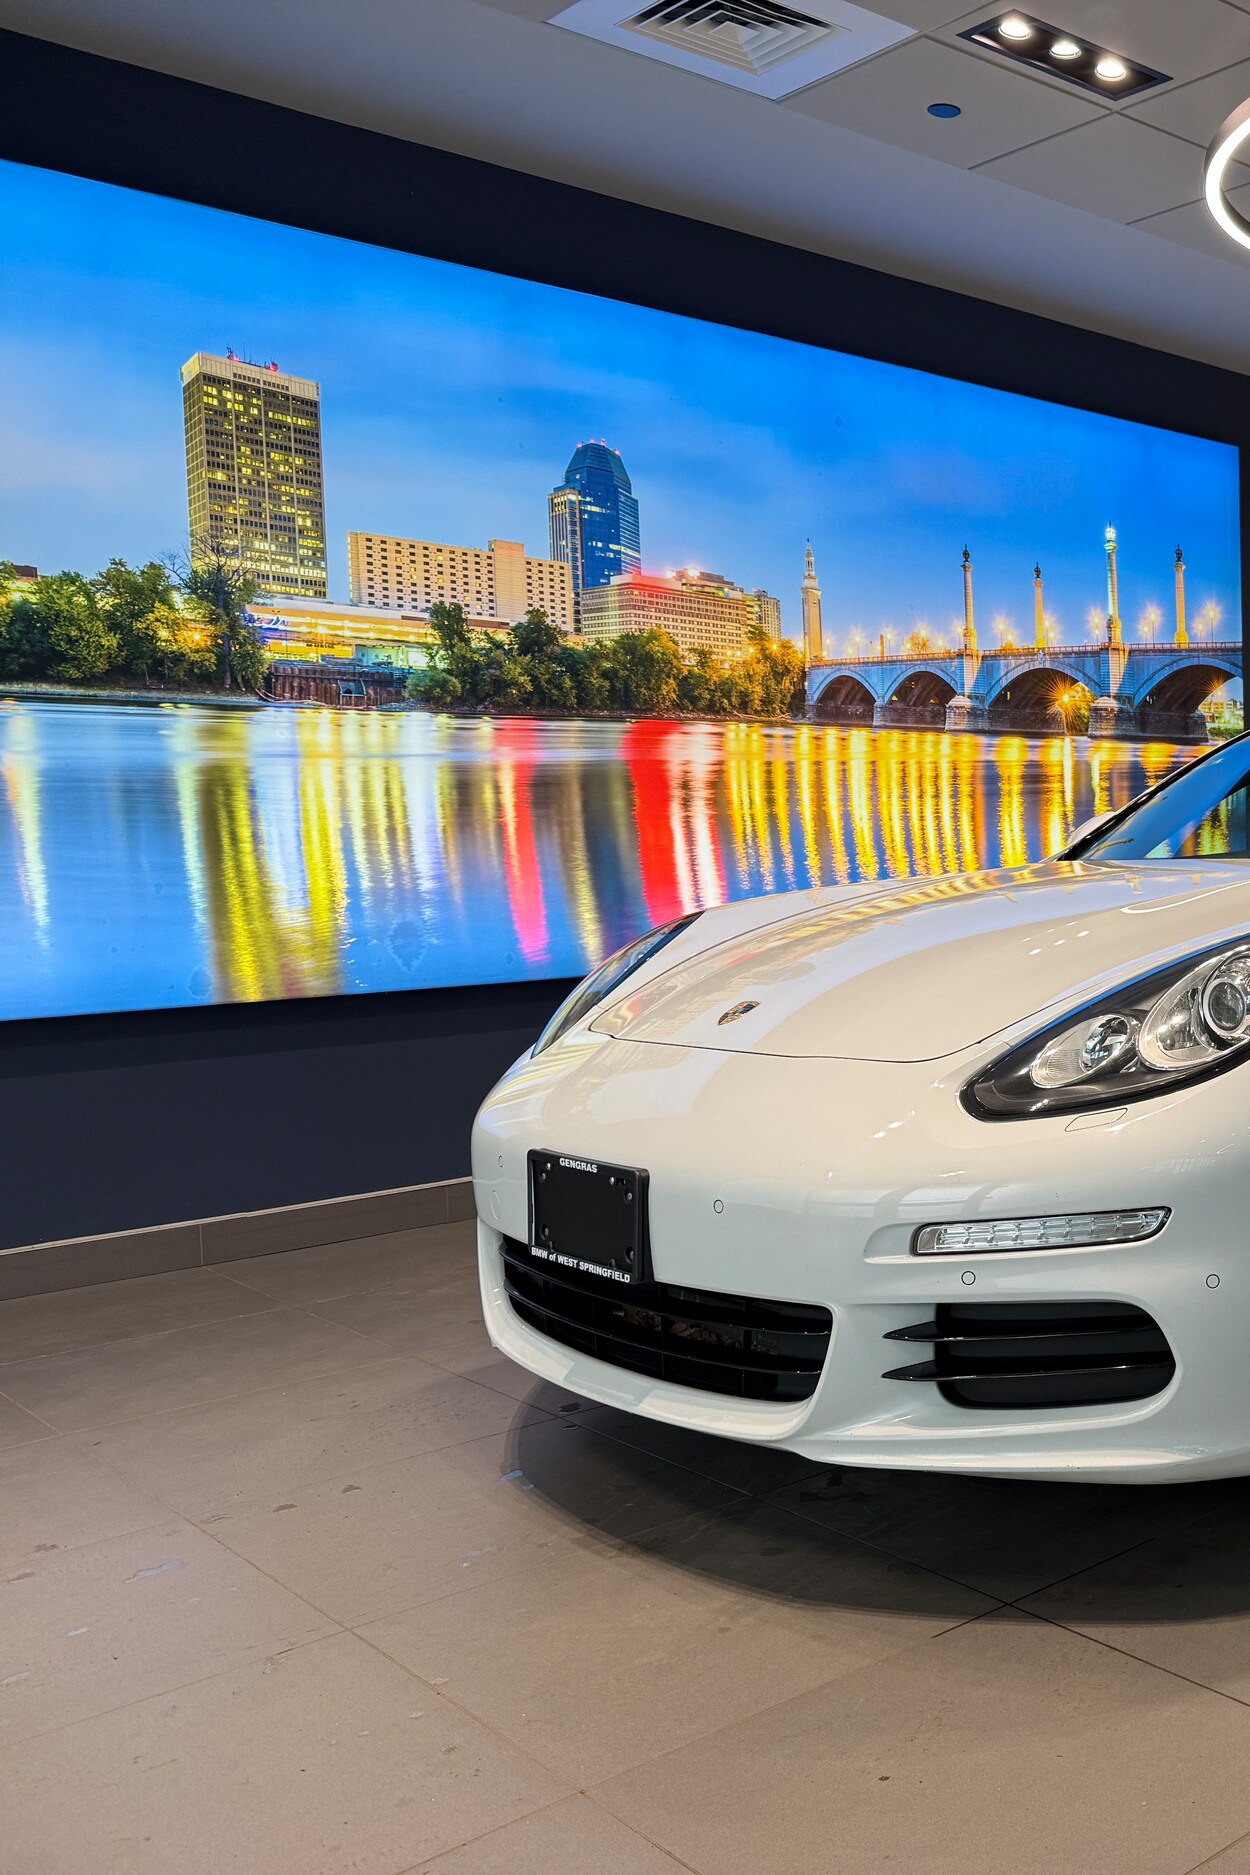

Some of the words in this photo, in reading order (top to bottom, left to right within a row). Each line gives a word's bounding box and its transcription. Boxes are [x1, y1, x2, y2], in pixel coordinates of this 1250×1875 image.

[559, 1158, 598, 1173] GENGRAS
[531, 1247, 548, 1259] BMW
[557, 1256, 578, 1268] WEST
[579, 1262, 630, 1283] SPRINGFIELD
